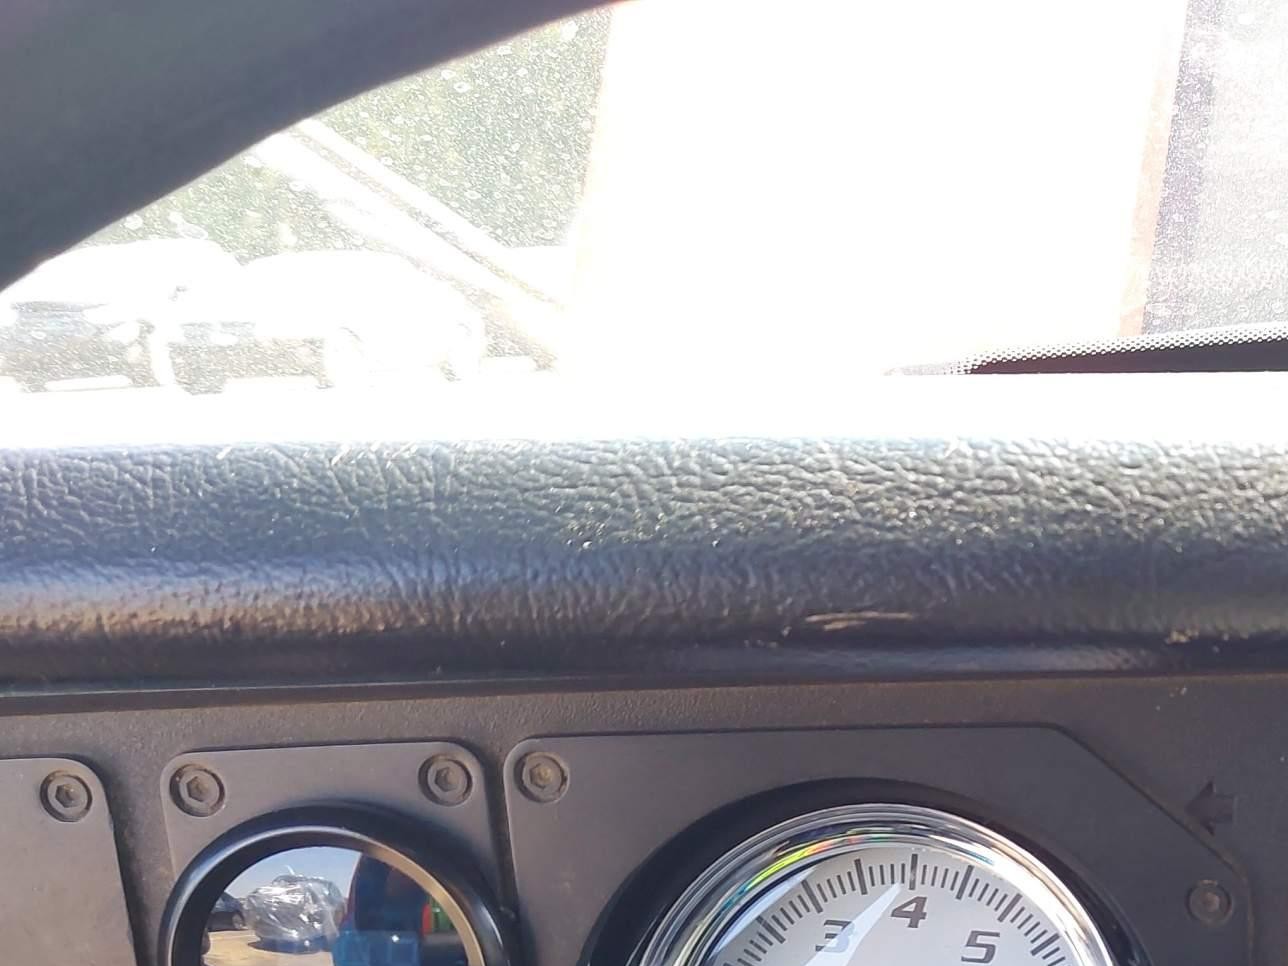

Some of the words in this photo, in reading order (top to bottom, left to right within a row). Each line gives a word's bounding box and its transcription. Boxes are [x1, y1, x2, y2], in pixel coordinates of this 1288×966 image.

[891, 896, 928, 928] 4
[815, 919, 856, 952] 3
[960, 930, 1001, 963] 5
